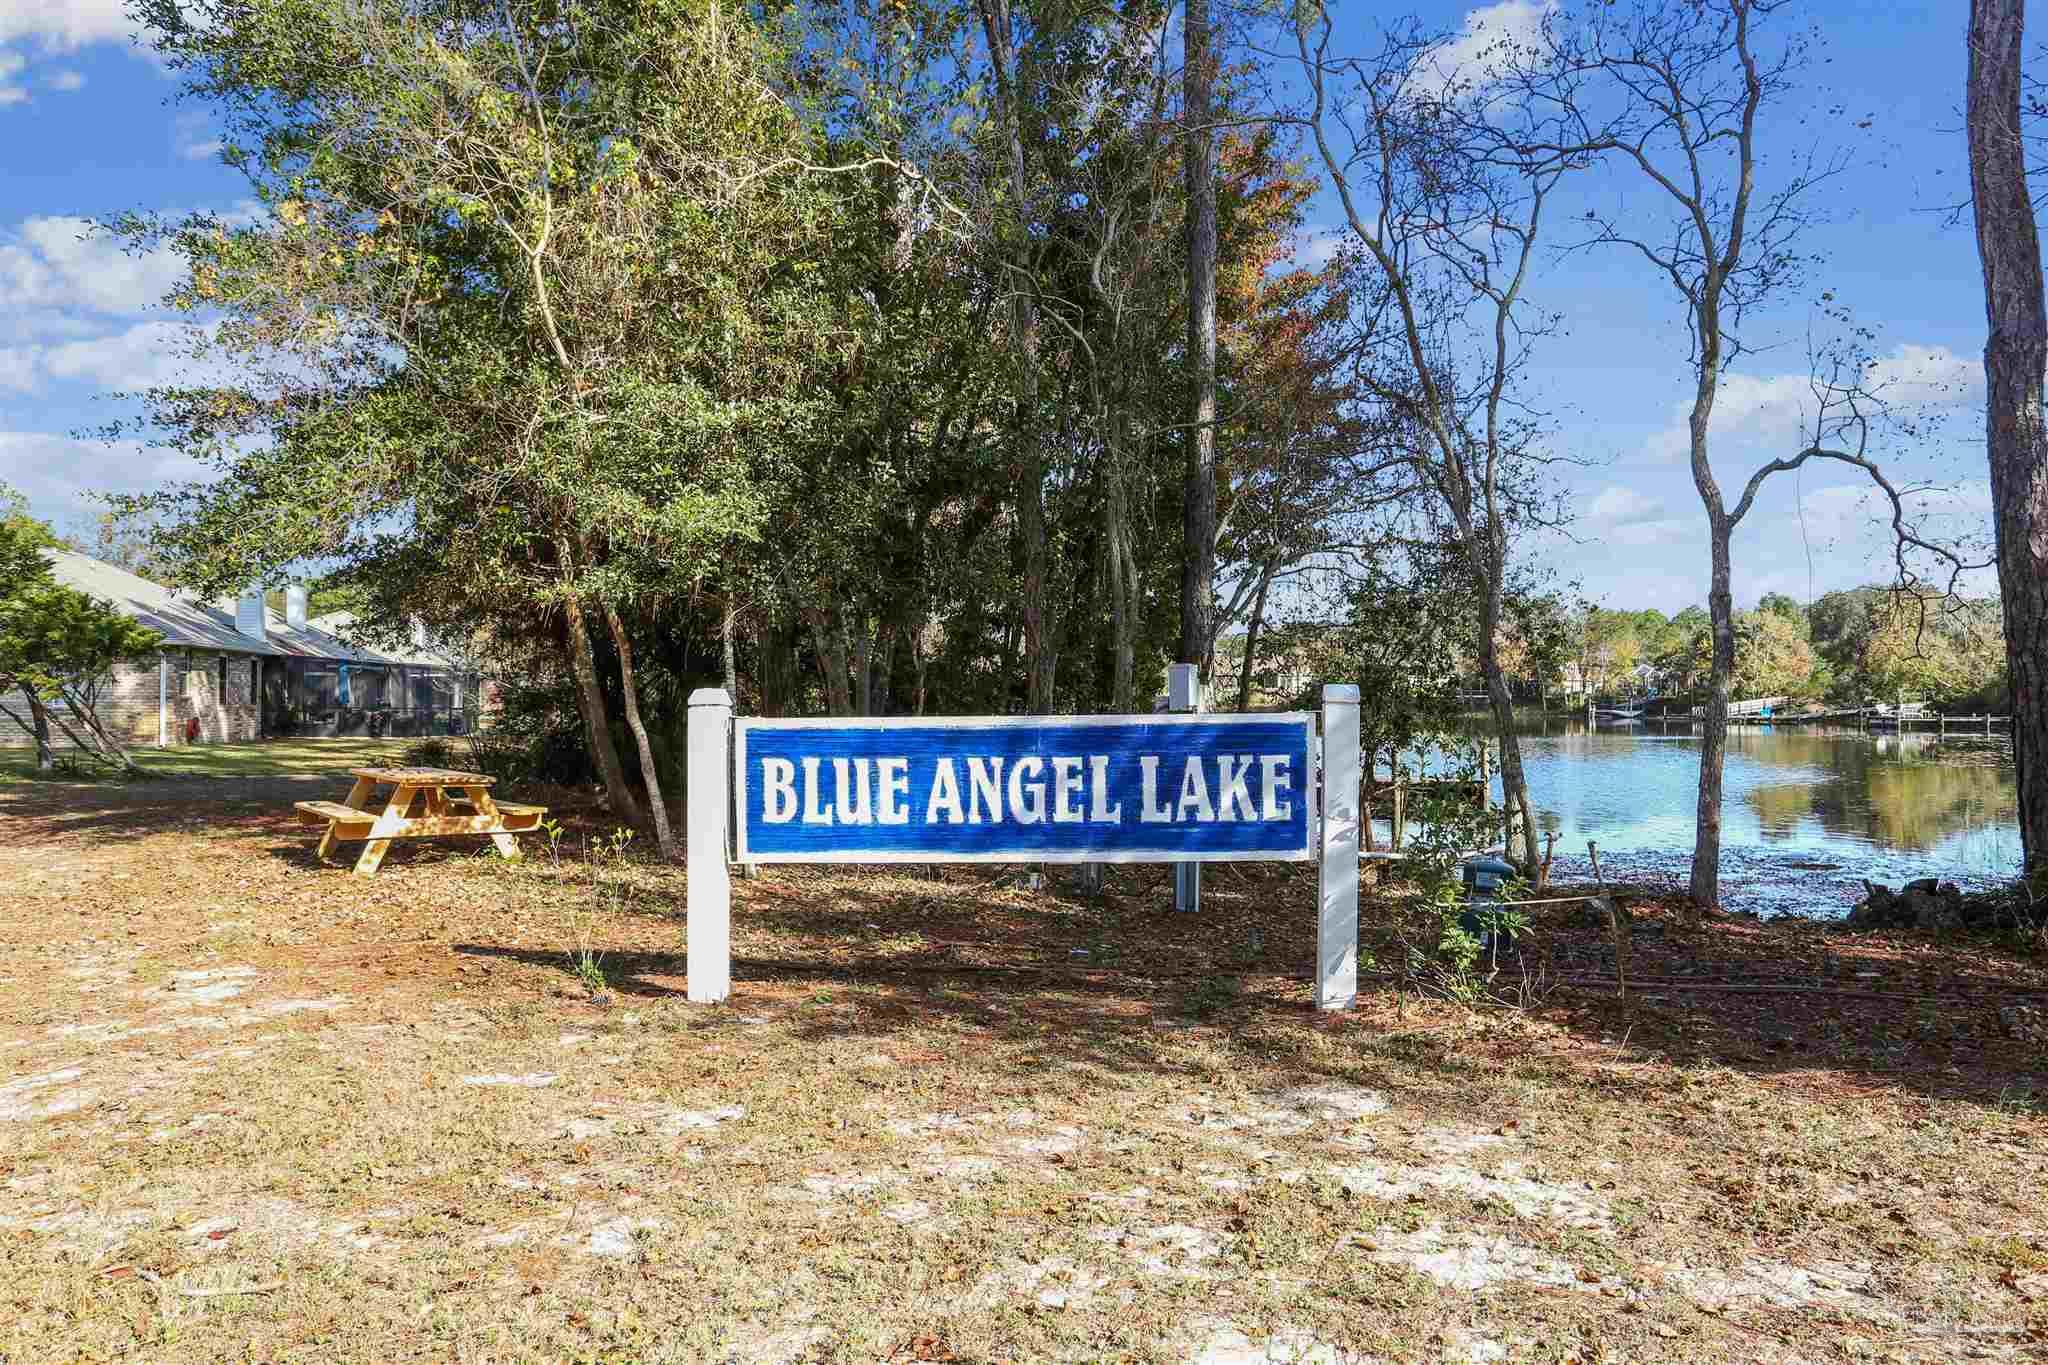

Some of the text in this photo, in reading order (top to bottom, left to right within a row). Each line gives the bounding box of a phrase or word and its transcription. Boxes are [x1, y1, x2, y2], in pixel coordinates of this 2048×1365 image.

[762, 755, 1292, 826] BLUE ANGEL LAKE
